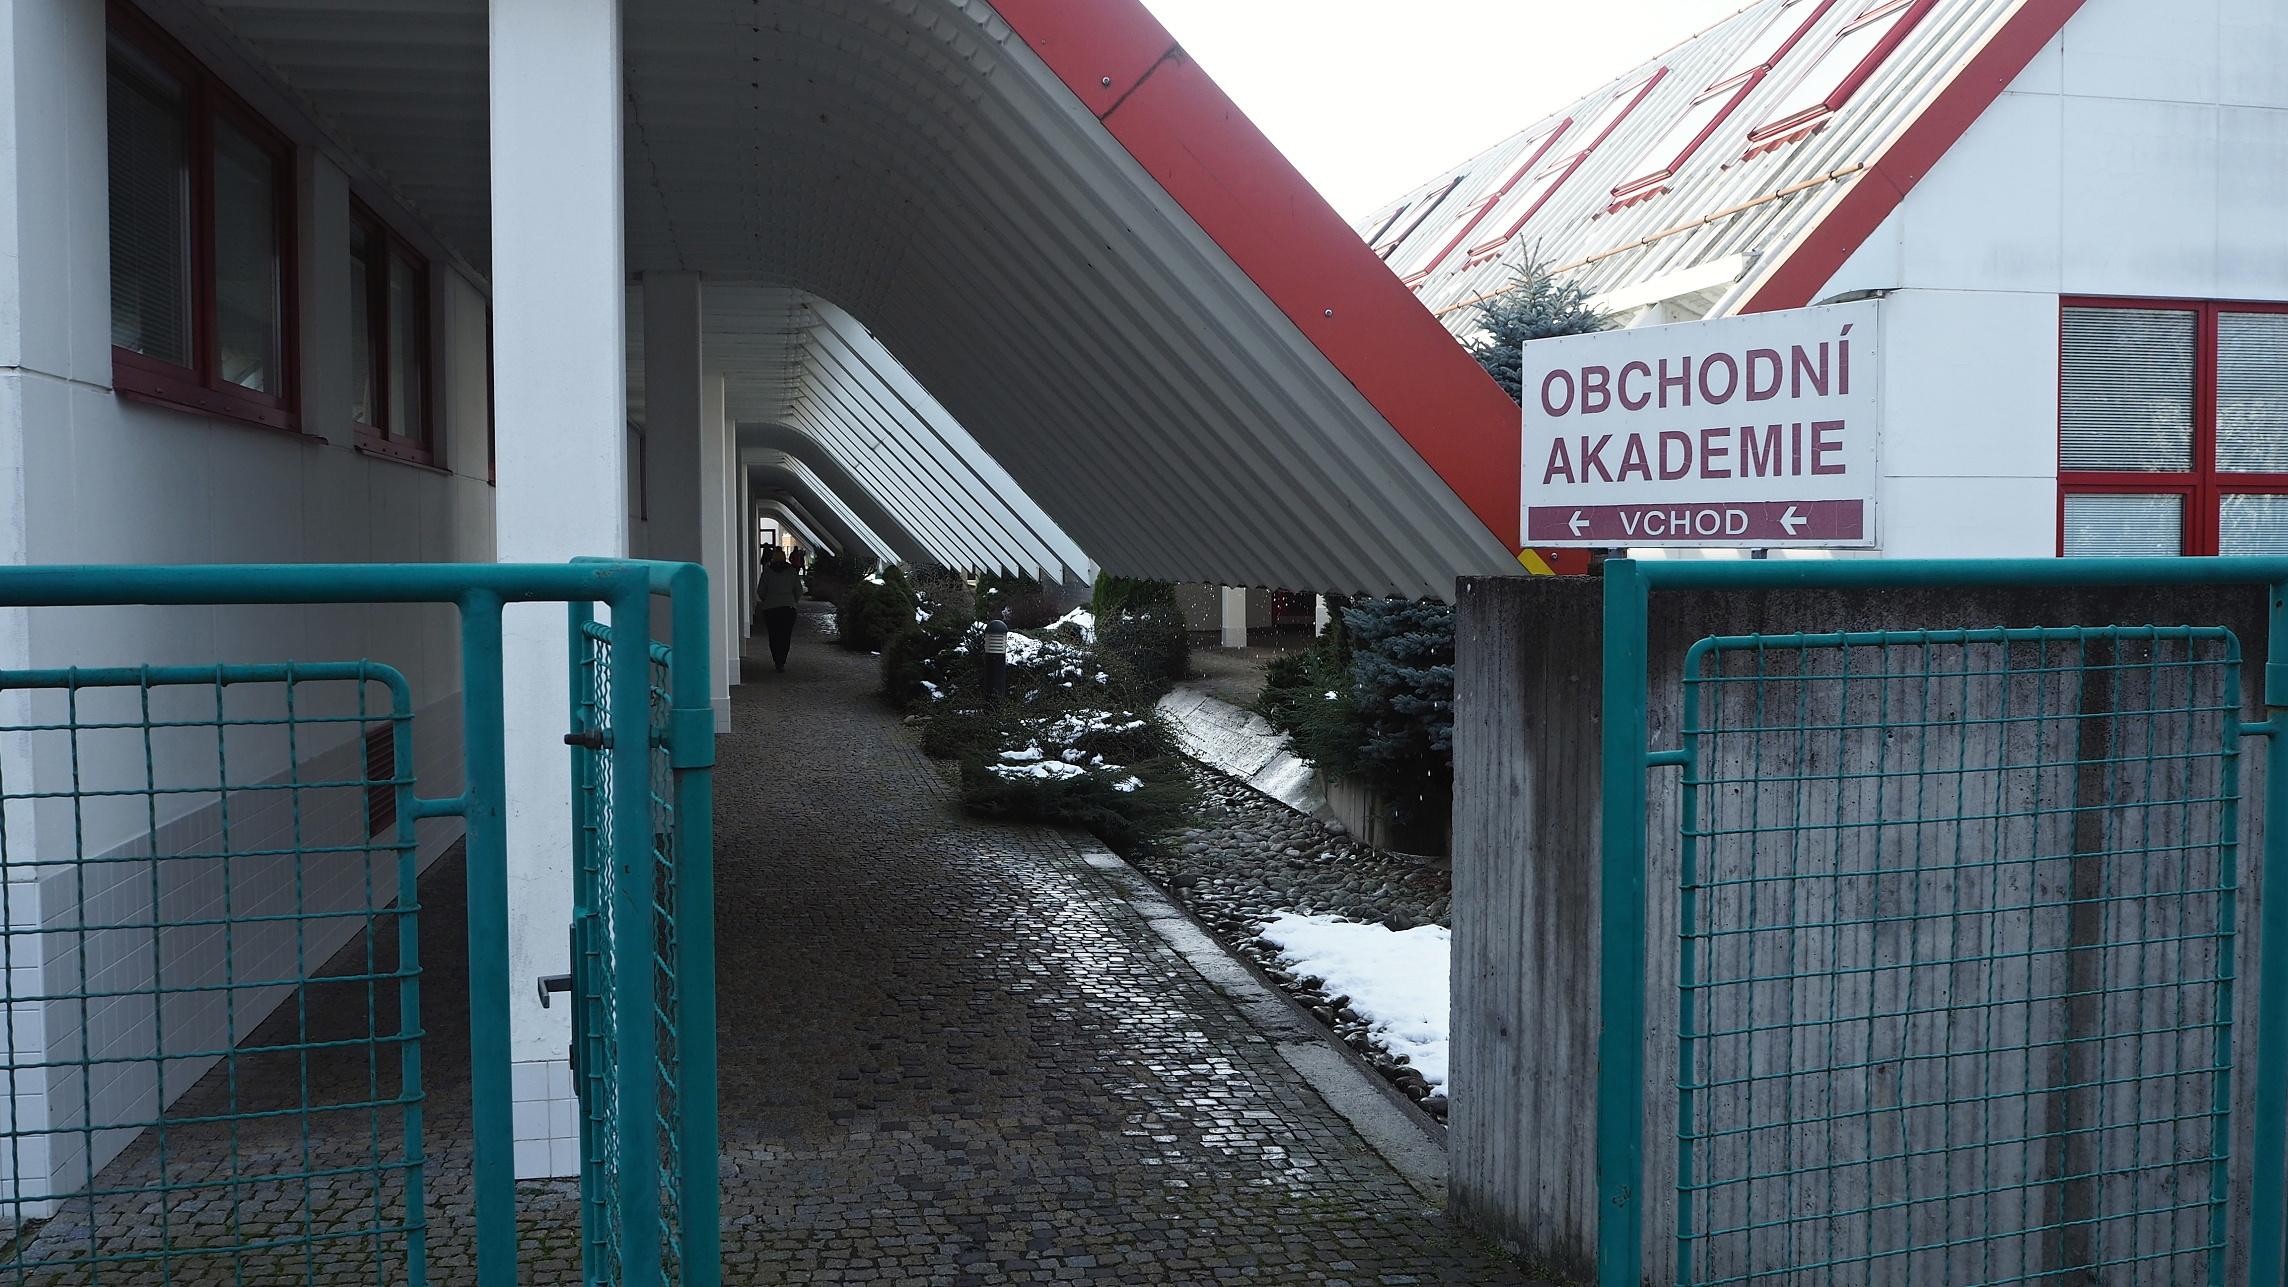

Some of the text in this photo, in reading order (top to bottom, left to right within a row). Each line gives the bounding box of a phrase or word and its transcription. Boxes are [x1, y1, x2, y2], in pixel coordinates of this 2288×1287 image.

[1541, 323, 1853, 417] OBCHODNÍ
[1542, 420, 1846, 485] AKADEMIE
[1619, 509, 1749, 536] VCHOD
